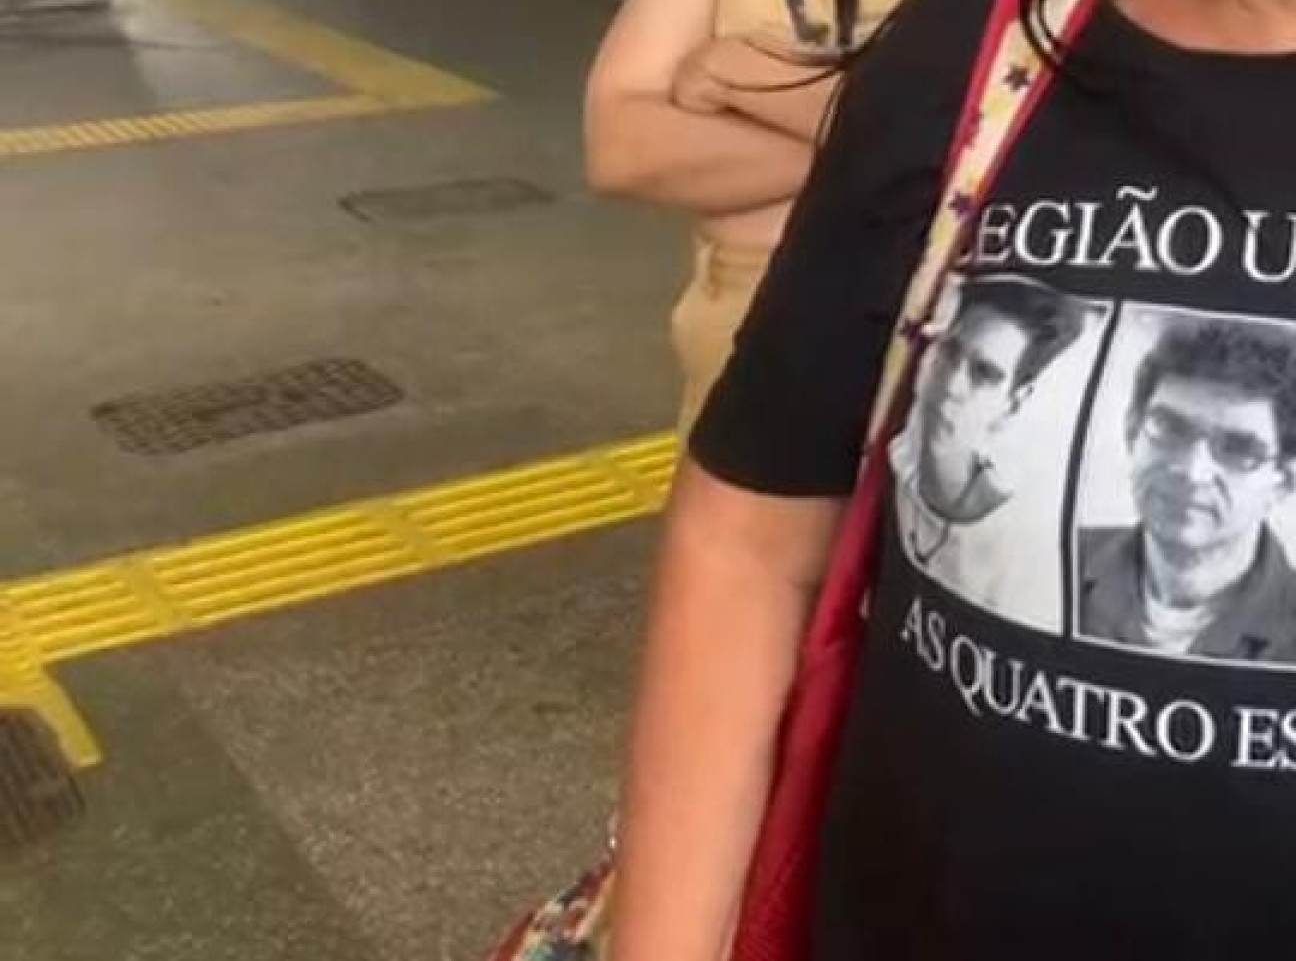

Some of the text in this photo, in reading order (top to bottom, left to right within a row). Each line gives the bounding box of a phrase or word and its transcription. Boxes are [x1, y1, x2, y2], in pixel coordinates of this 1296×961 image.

[954, 184, 1223, 275] EGIÃO
[901, 596, 946, 672] AS
[949, 633, 1216, 764] QUATRO
